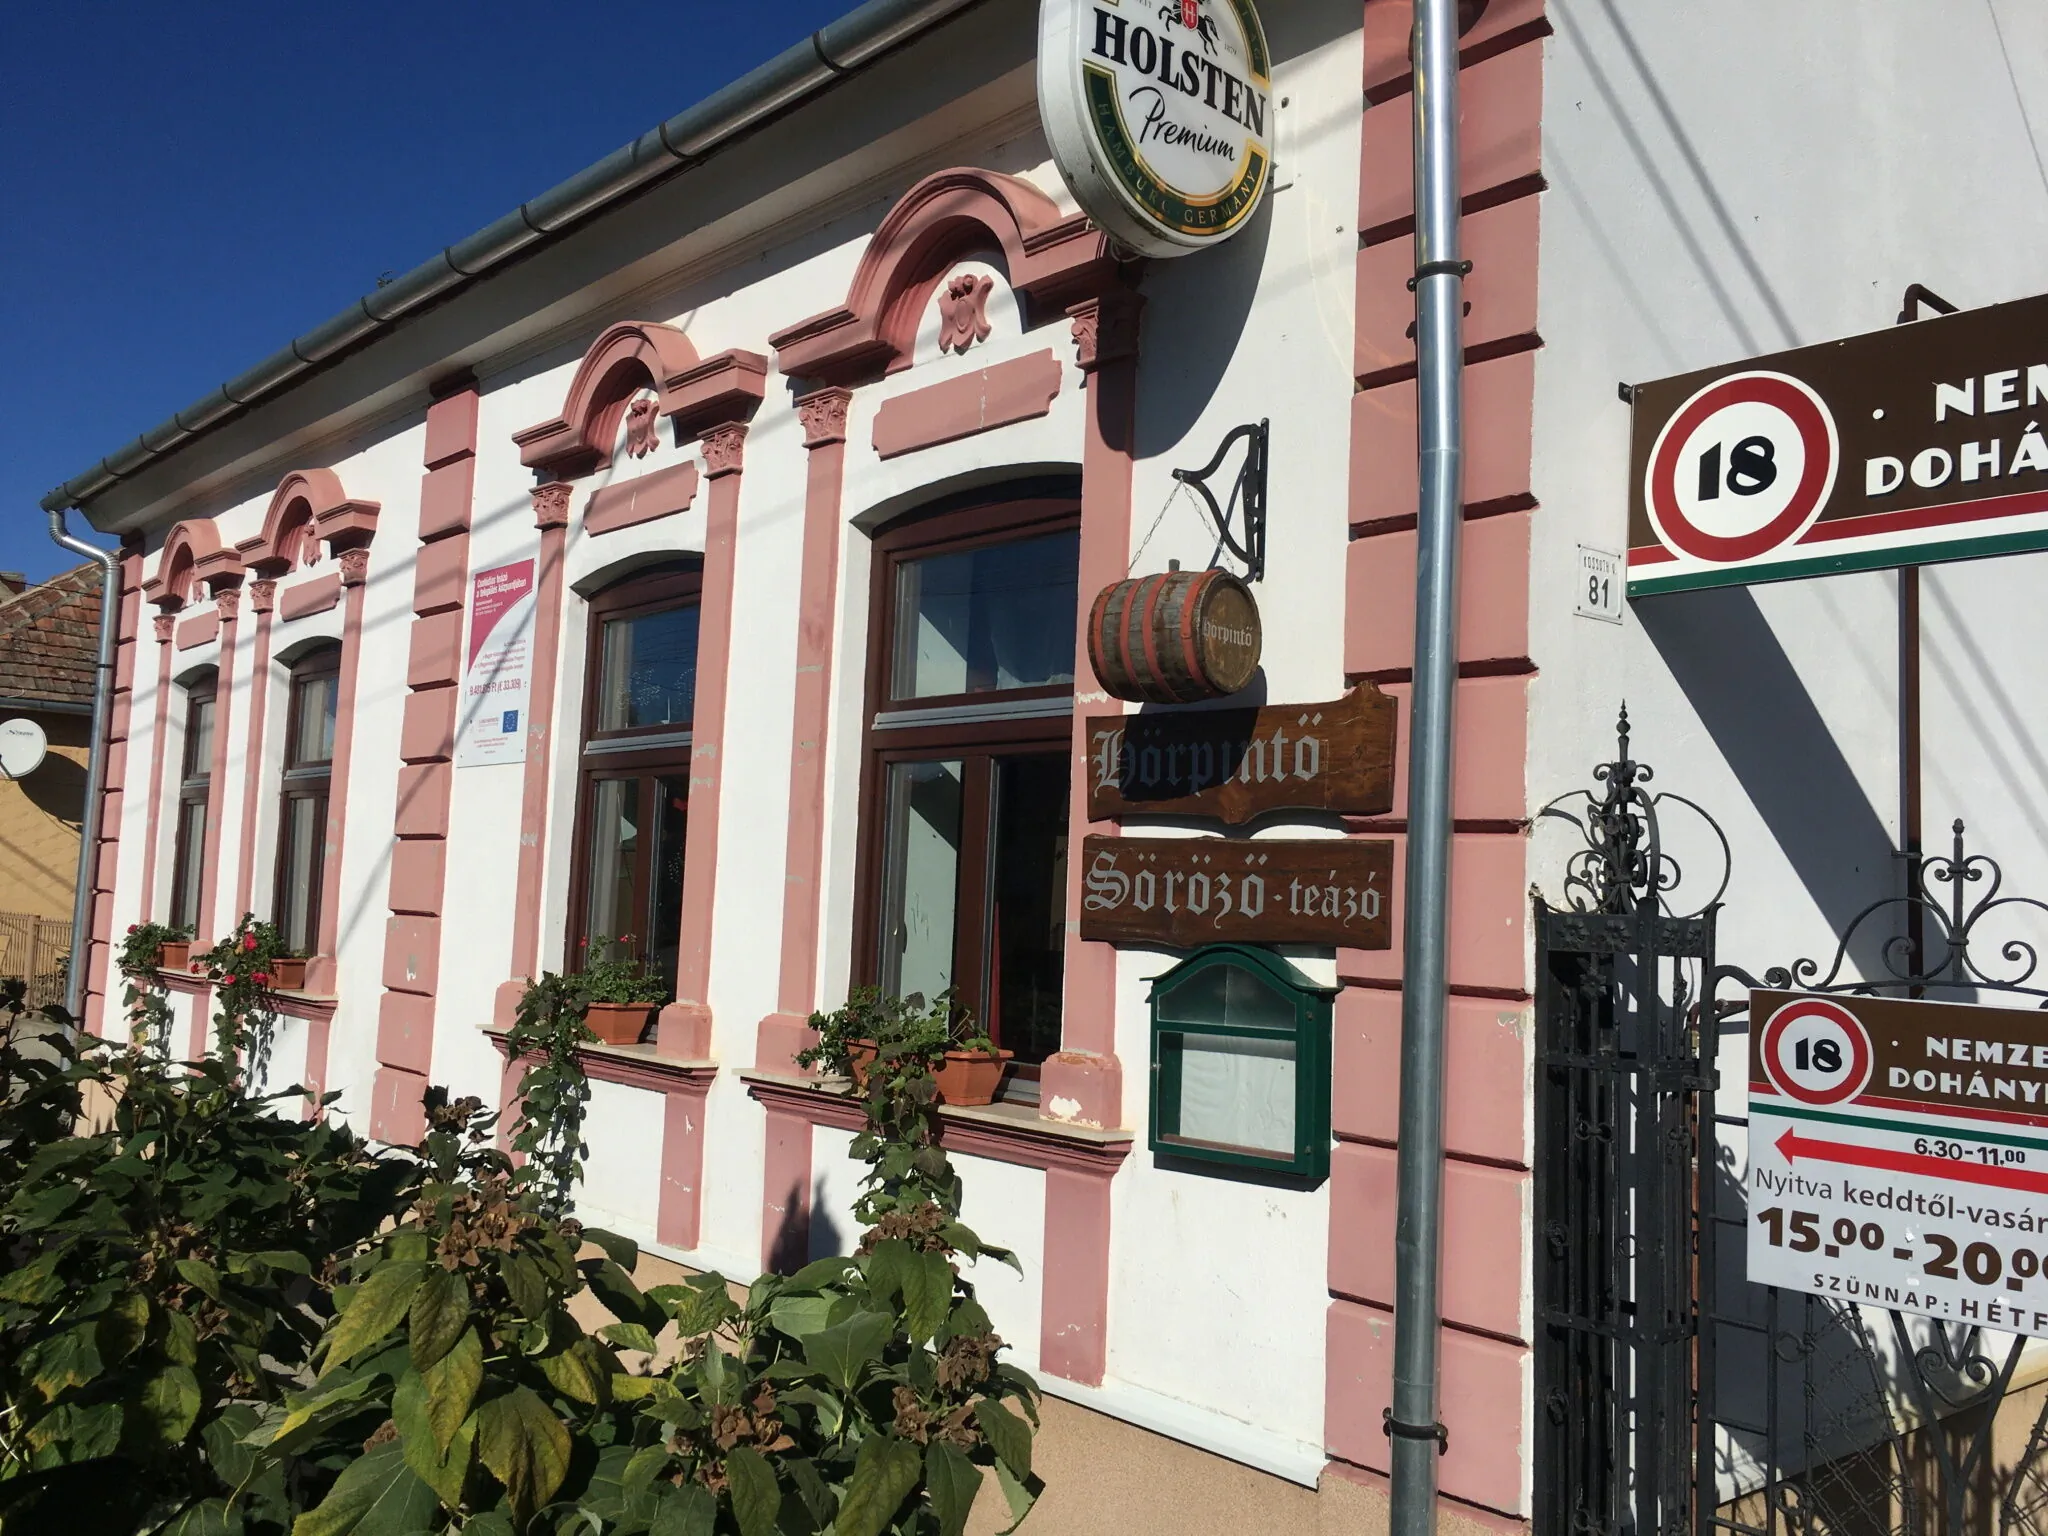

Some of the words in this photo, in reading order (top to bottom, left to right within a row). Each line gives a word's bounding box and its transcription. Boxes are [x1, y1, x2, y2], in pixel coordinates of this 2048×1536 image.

[1091, 6, 1267, 138] HOLSTEN
[1129, 86, 1236, 162] Premium
[1184, 170, 1258, 225] GERMANY
[1697, 435, 1778, 501] 18
[1588, 575, 1609, 608] 81
[1084, 849, 1268, 929] Söröző
[1795, 1038, 1842, 1073] 18
[1926, 1036, 2048, 1068] NEMZE
[1889, 1067, 2048, 1105] DOHÁNY
[1756, 1167, 1832, 1200] Nyitva
[1813, 1273, 1950, 1315] SZÜNNAP:
